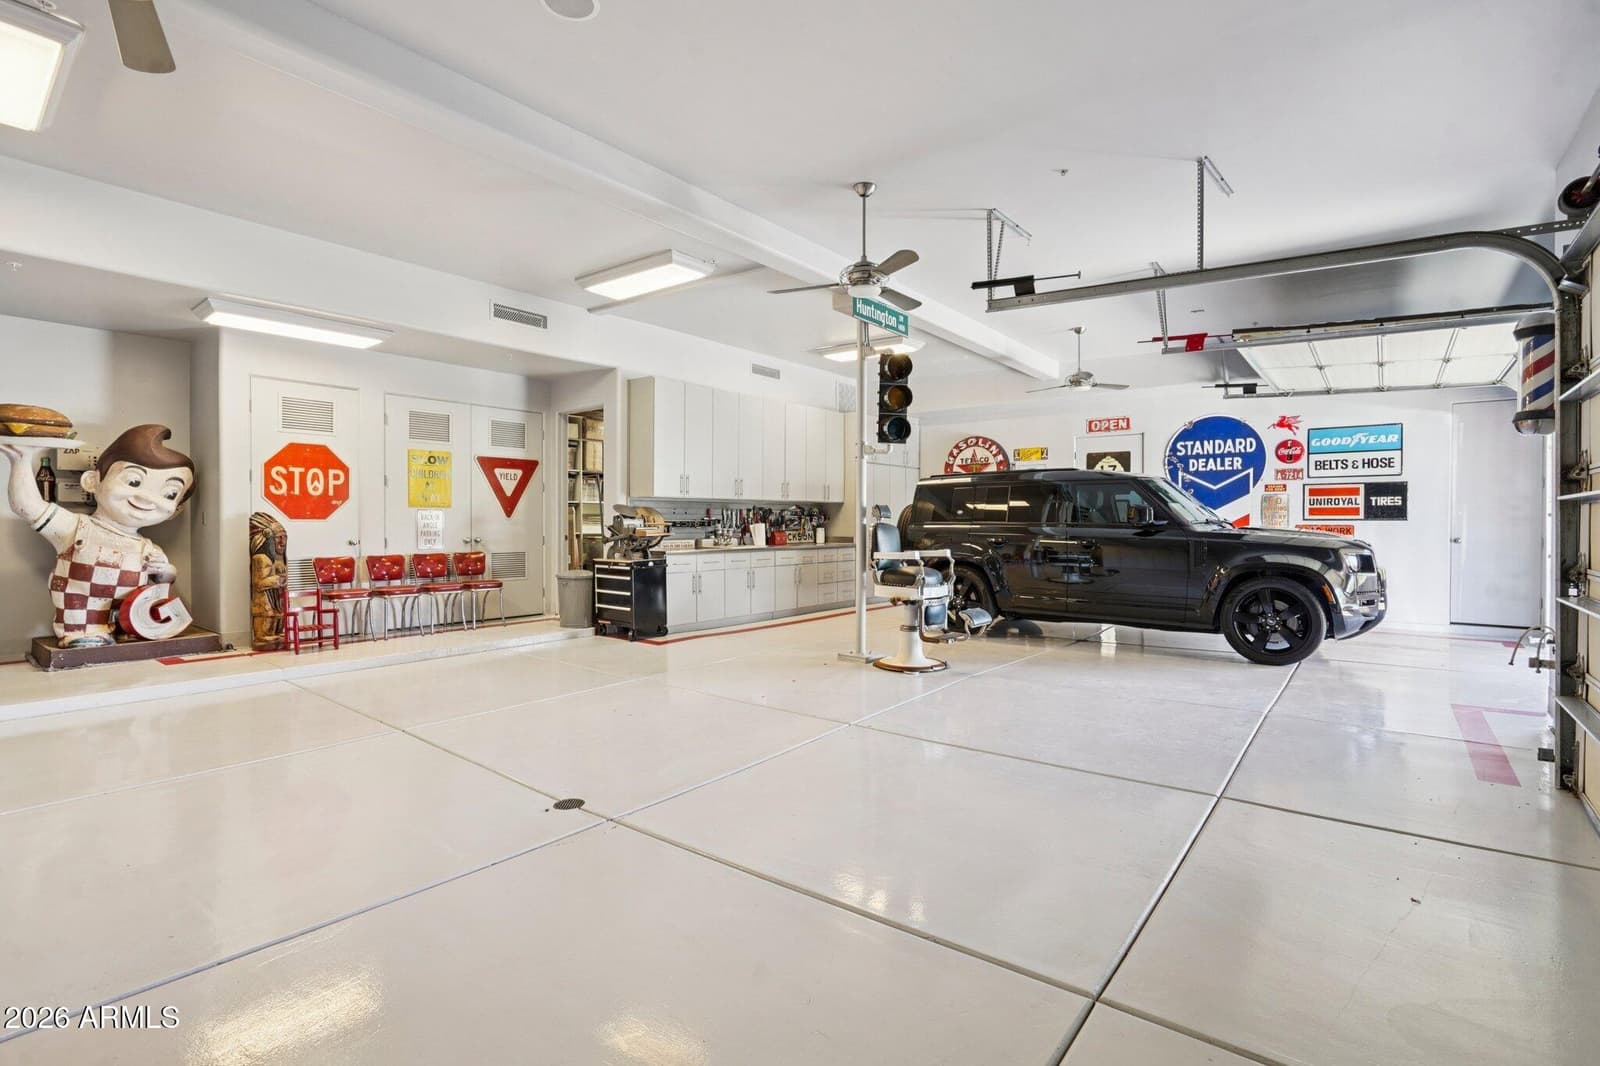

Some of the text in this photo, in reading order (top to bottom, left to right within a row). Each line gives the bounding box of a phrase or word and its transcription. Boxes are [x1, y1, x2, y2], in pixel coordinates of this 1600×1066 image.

[856, 298, 897, 328] Huntington
[1091, 419, 1127, 431] OPEN
[1176, 437, 1257, 456] STANDARD
[1311, 432, 1399, 448] GOODYEAR
[947, 438, 1005, 464] GASOLINE
[959, 457, 990, 465] TEXCO
[1188, 457, 1243, 472] DEALER
[1314, 457, 1395, 471] BELTS & HOSE
[269, 465, 345, 497] STOP
[499, 472, 518, 481] YIELD
[1309, 496, 1402, 506] UNIROYAL TIRES
